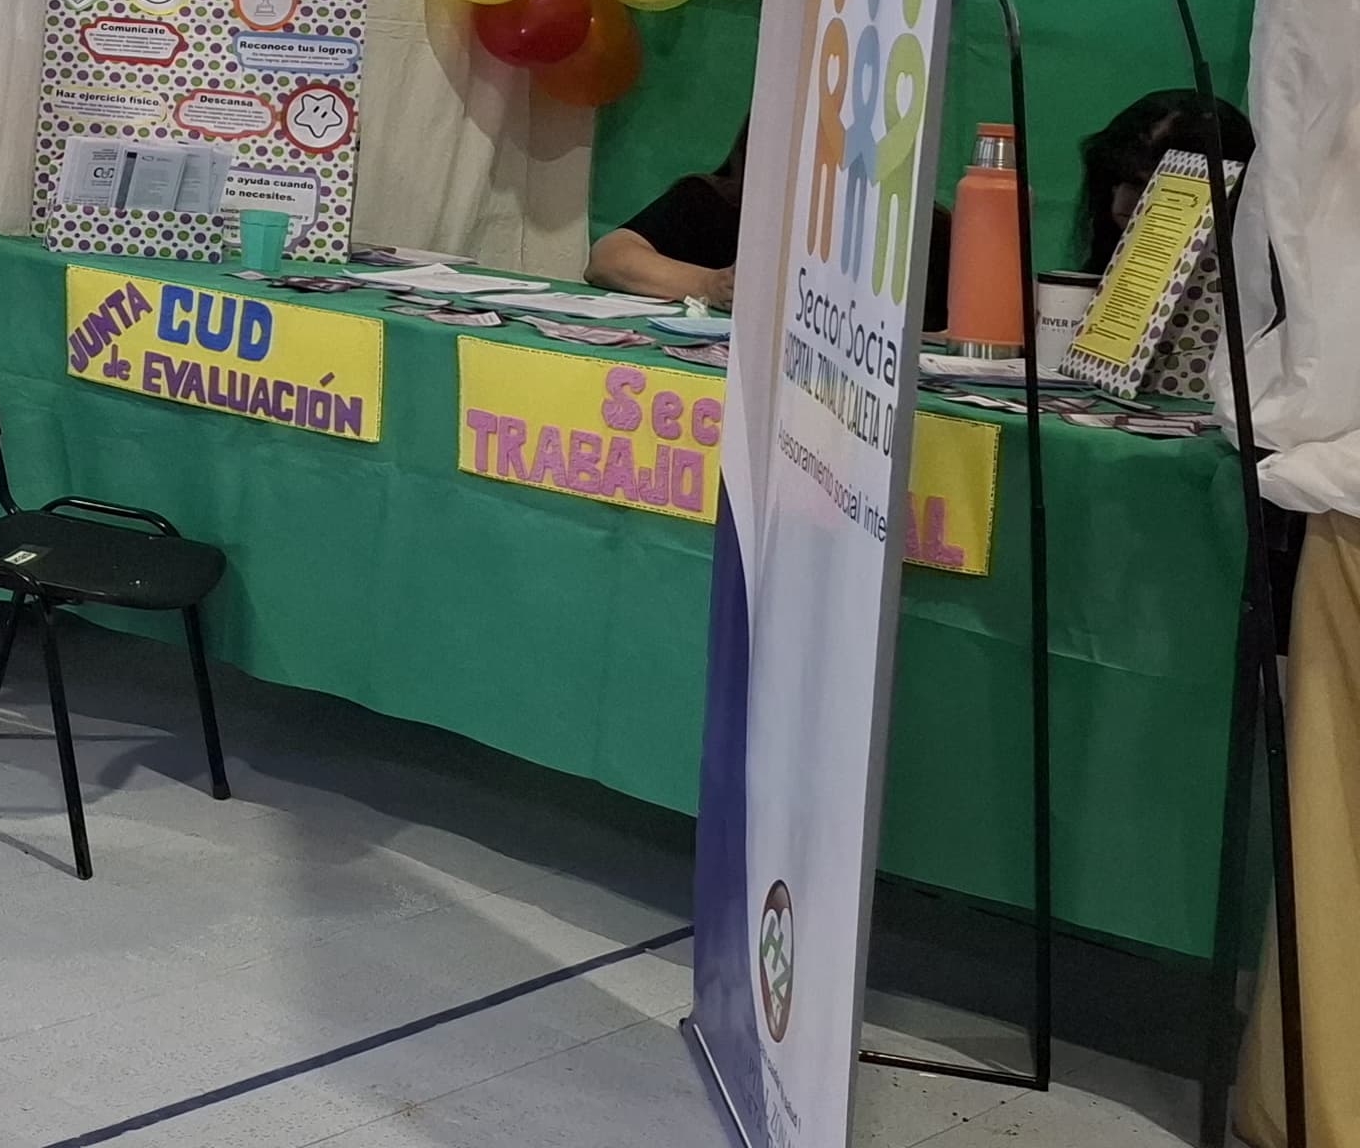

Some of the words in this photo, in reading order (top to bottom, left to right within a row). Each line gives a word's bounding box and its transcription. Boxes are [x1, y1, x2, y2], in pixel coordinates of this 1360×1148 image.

[100, 22, 166, 35] Comunicate
[239, 40, 295, 52] Reconoce
[298, 44, 315, 53] tus
[318, 45, 353, 56] logros
[55, 88, 76, 99] Haz
[79, 91, 127, 104] ejercicio
[199, 94, 254, 108] Descansa
[225, 187, 237, 196] lo
[239, 190, 297, 202] necesites.
[237, 176, 271, 187] ayuda
[273, 180, 315, 191] cuando
[68, 281, 154, 374] JUNTA
[156, 283, 274, 363] CUD
[795, 267, 846, 350] Sector
[1041, 315, 1069, 328] RIVER
[102, 343, 133, 381] de
[142, 350, 364, 437] EVALUACIÓN
[601, 366, 722, 447] Sec
[847, 379, 881, 450] CALETA
[466, 408, 706, 513] TRABAJO
[834, 479, 863, 525] social
